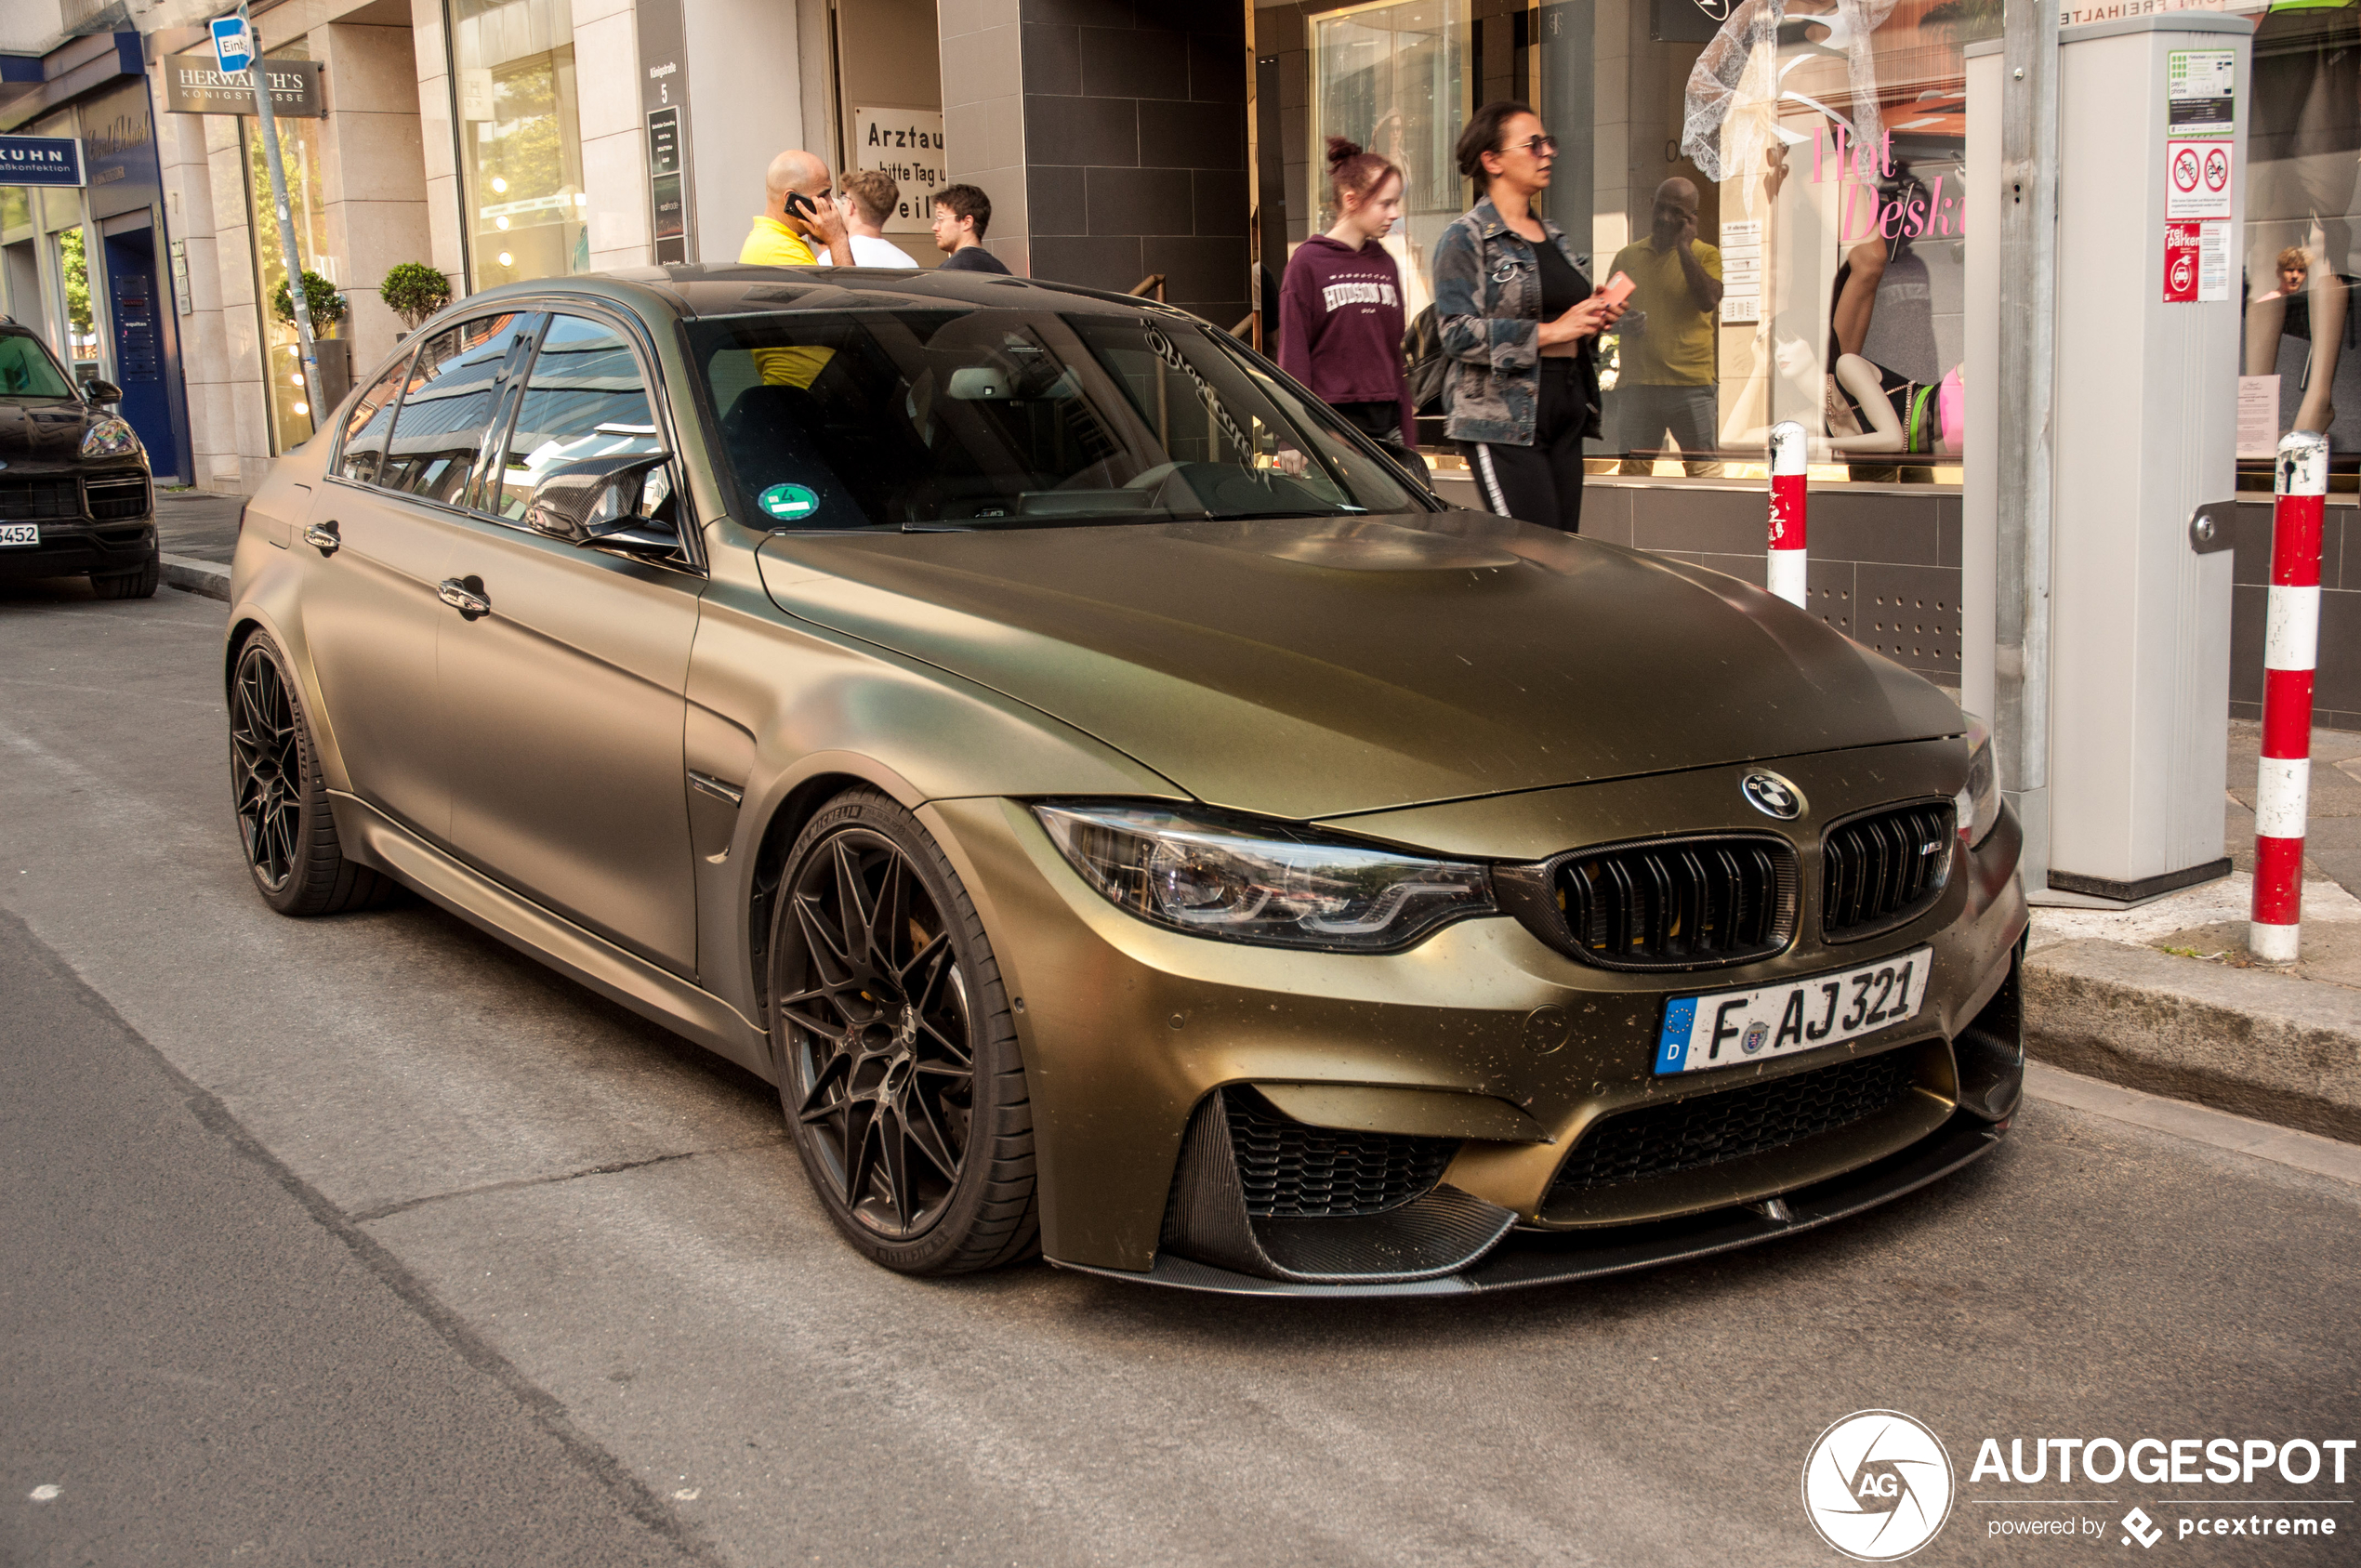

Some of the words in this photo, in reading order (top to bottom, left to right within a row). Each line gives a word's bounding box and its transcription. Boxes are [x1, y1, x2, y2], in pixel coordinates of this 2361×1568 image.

[179, 69, 303, 89] HERWAH'S
[650, 61, 677, 79] Königstraße
[182, 90, 303, 102] KÖNIGSTSSE
[661, 83, 668, 104] 5
[868, 123, 943, 150] Arztau
[1810, 124, 1896, 183] Hot
[912, 163, 935, 188] Tag
[2164, 225, 2184, 239] Frei
[2167, 233, 2200, 250] parken
[781, 488, 796, 502] 4
[809, 805, 863, 838] MICHELIN
[1708, 998, 1748, 1060] F
[1667, 1044, 1680, 1060] D
